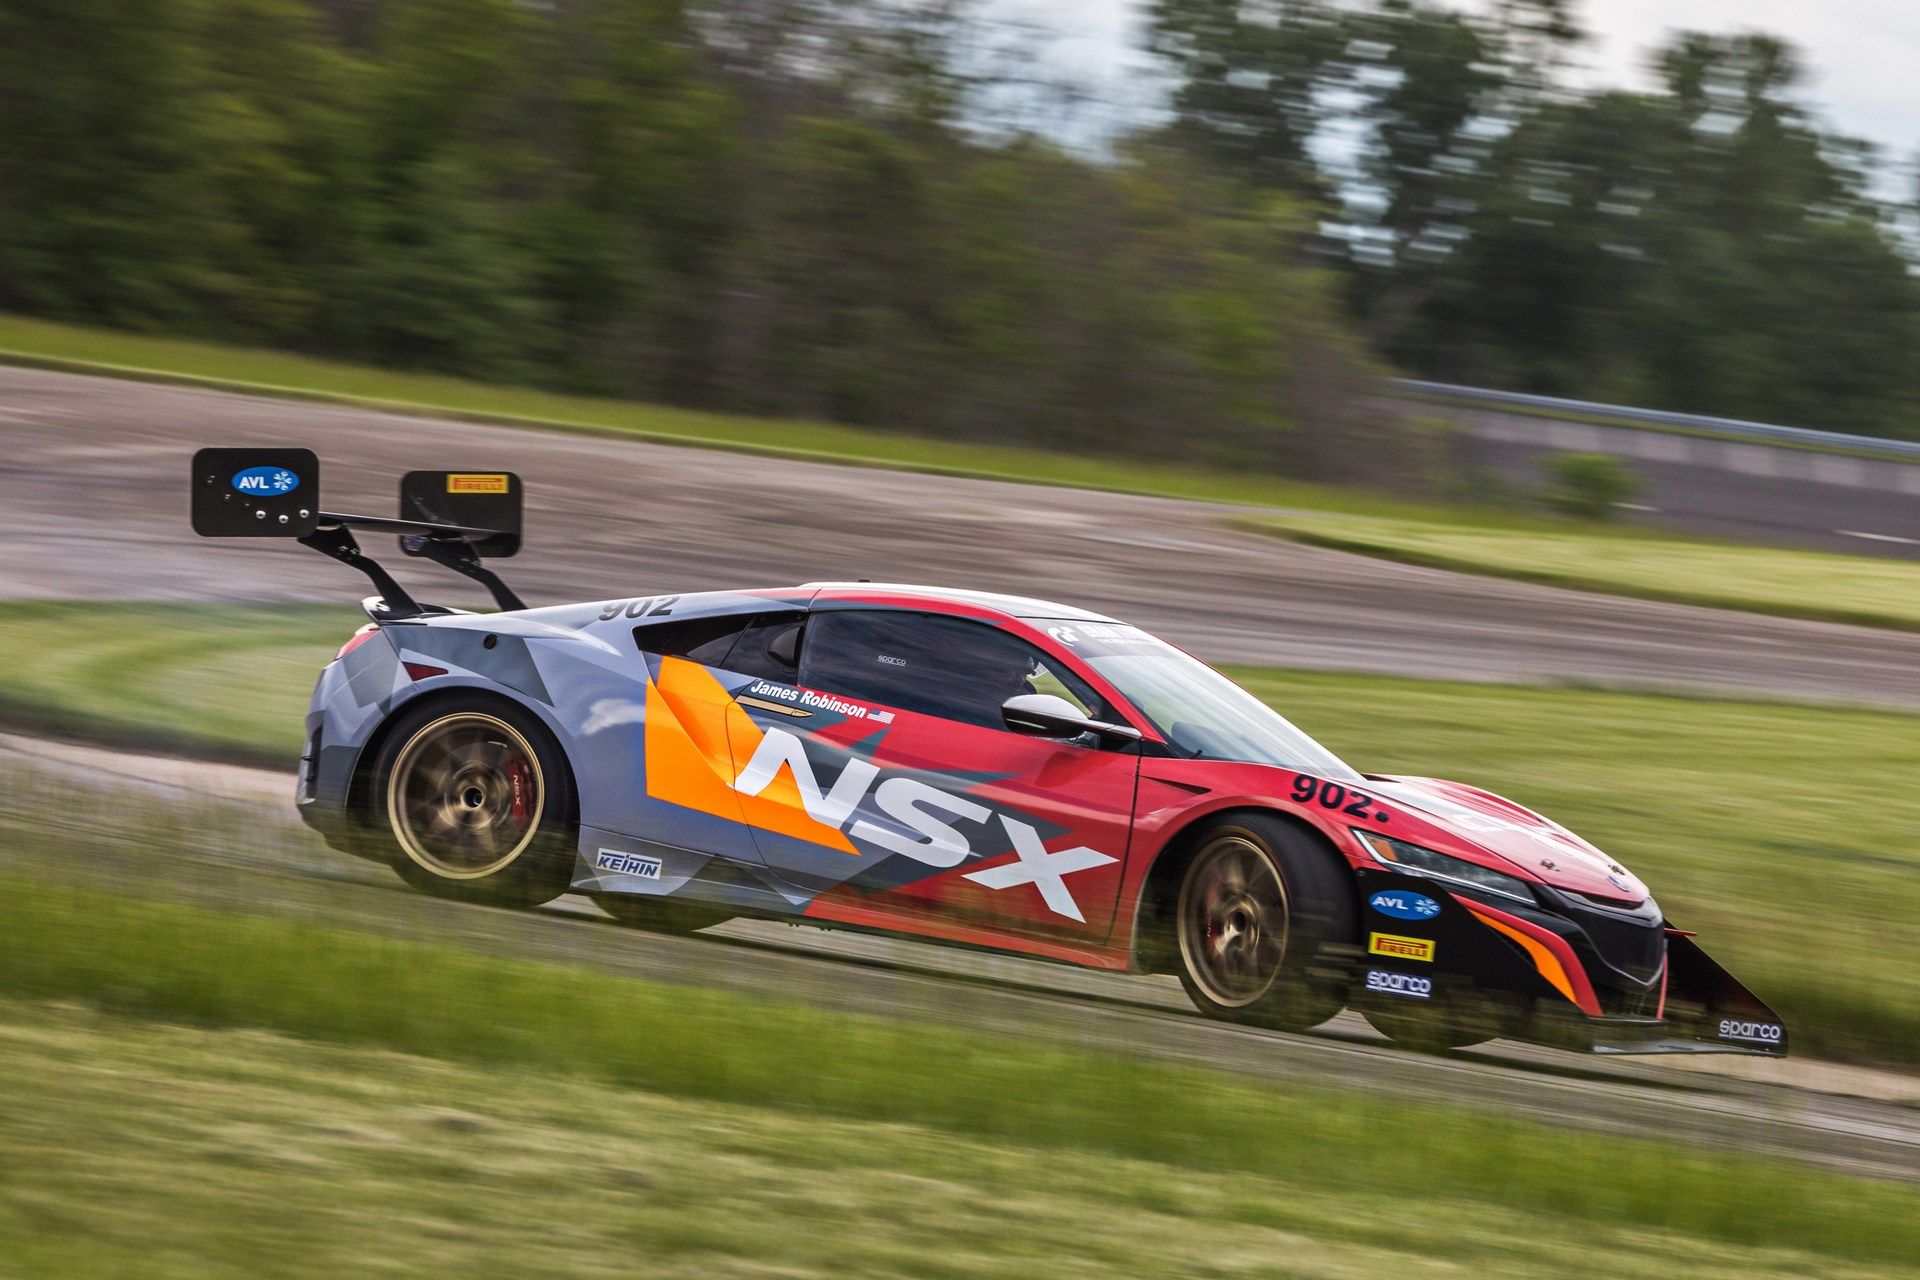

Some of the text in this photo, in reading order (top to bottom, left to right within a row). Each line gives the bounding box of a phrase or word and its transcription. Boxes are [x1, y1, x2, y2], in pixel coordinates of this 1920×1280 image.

[239, 476, 270, 489] AVL
[453, 478, 504, 490] PIRELLI
[599, 597, 680, 621] 902
[877, 655, 906, 667] sparco
[751, 681, 867, 719] James Robinson
[726, 727, 1120, 924] NSX
[597, 856, 658, 876] KEIHIN
[1372, 896, 1409, 910] AVL
[1376, 937, 1429, 958] PIRELLI
[1366, 971, 1432, 996] sparco
[1719, 1020, 1780, 1041] sparco
